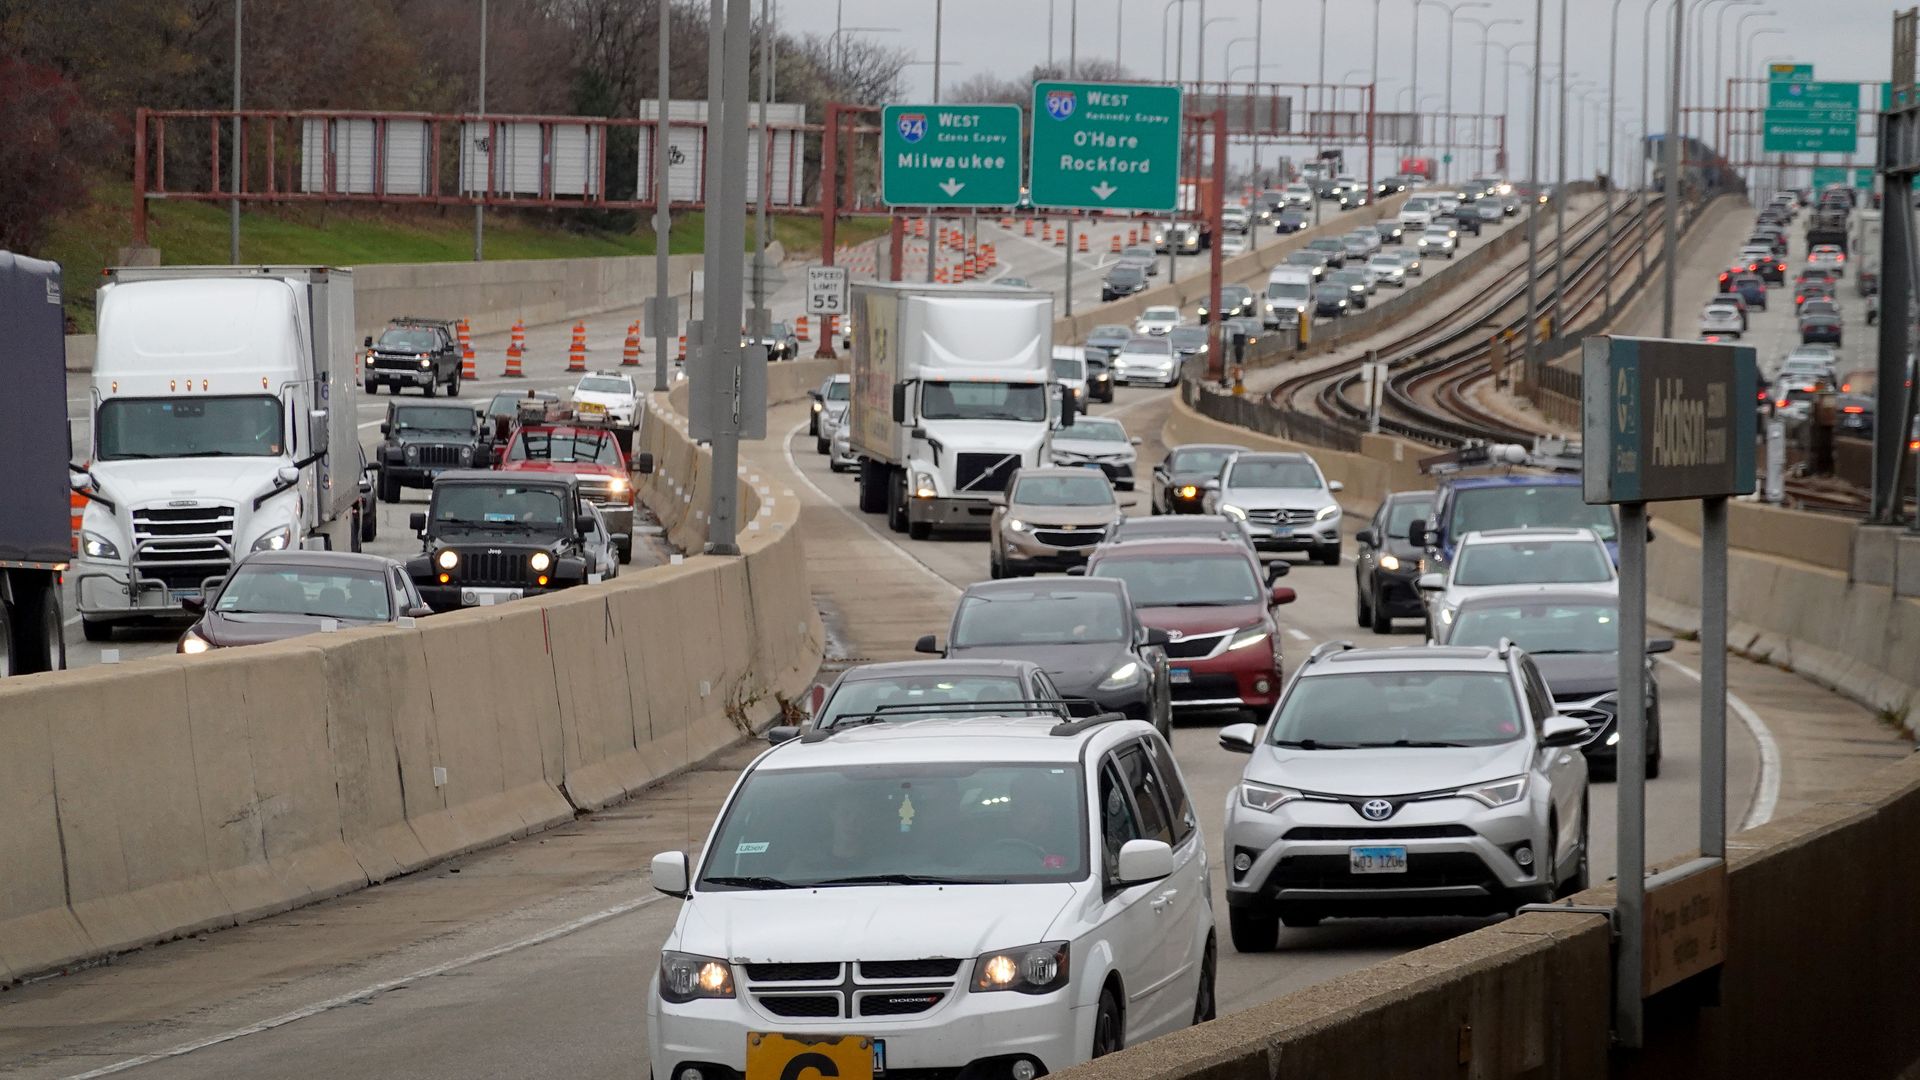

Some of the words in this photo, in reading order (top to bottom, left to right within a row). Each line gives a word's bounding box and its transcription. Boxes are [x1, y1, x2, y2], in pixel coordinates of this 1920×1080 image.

[1049, 97, 1073, 115] 90
[1086, 91, 1129, 107] WEST
[900, 120, 923, 136] 94
[938, 112, 980, 127] WEST
[1074, 130, 1138, 149] O'Hare
[898, 153, 1006, 169] Milwaukee
[1060, 154, 1150, 174] Rockford
[811, 270, 843, 279] SPEED
[813, 283, 838, 291] LIMIT
[813, 294, 839, 309] 55
[1652, 377, 1705, 467] Addison
